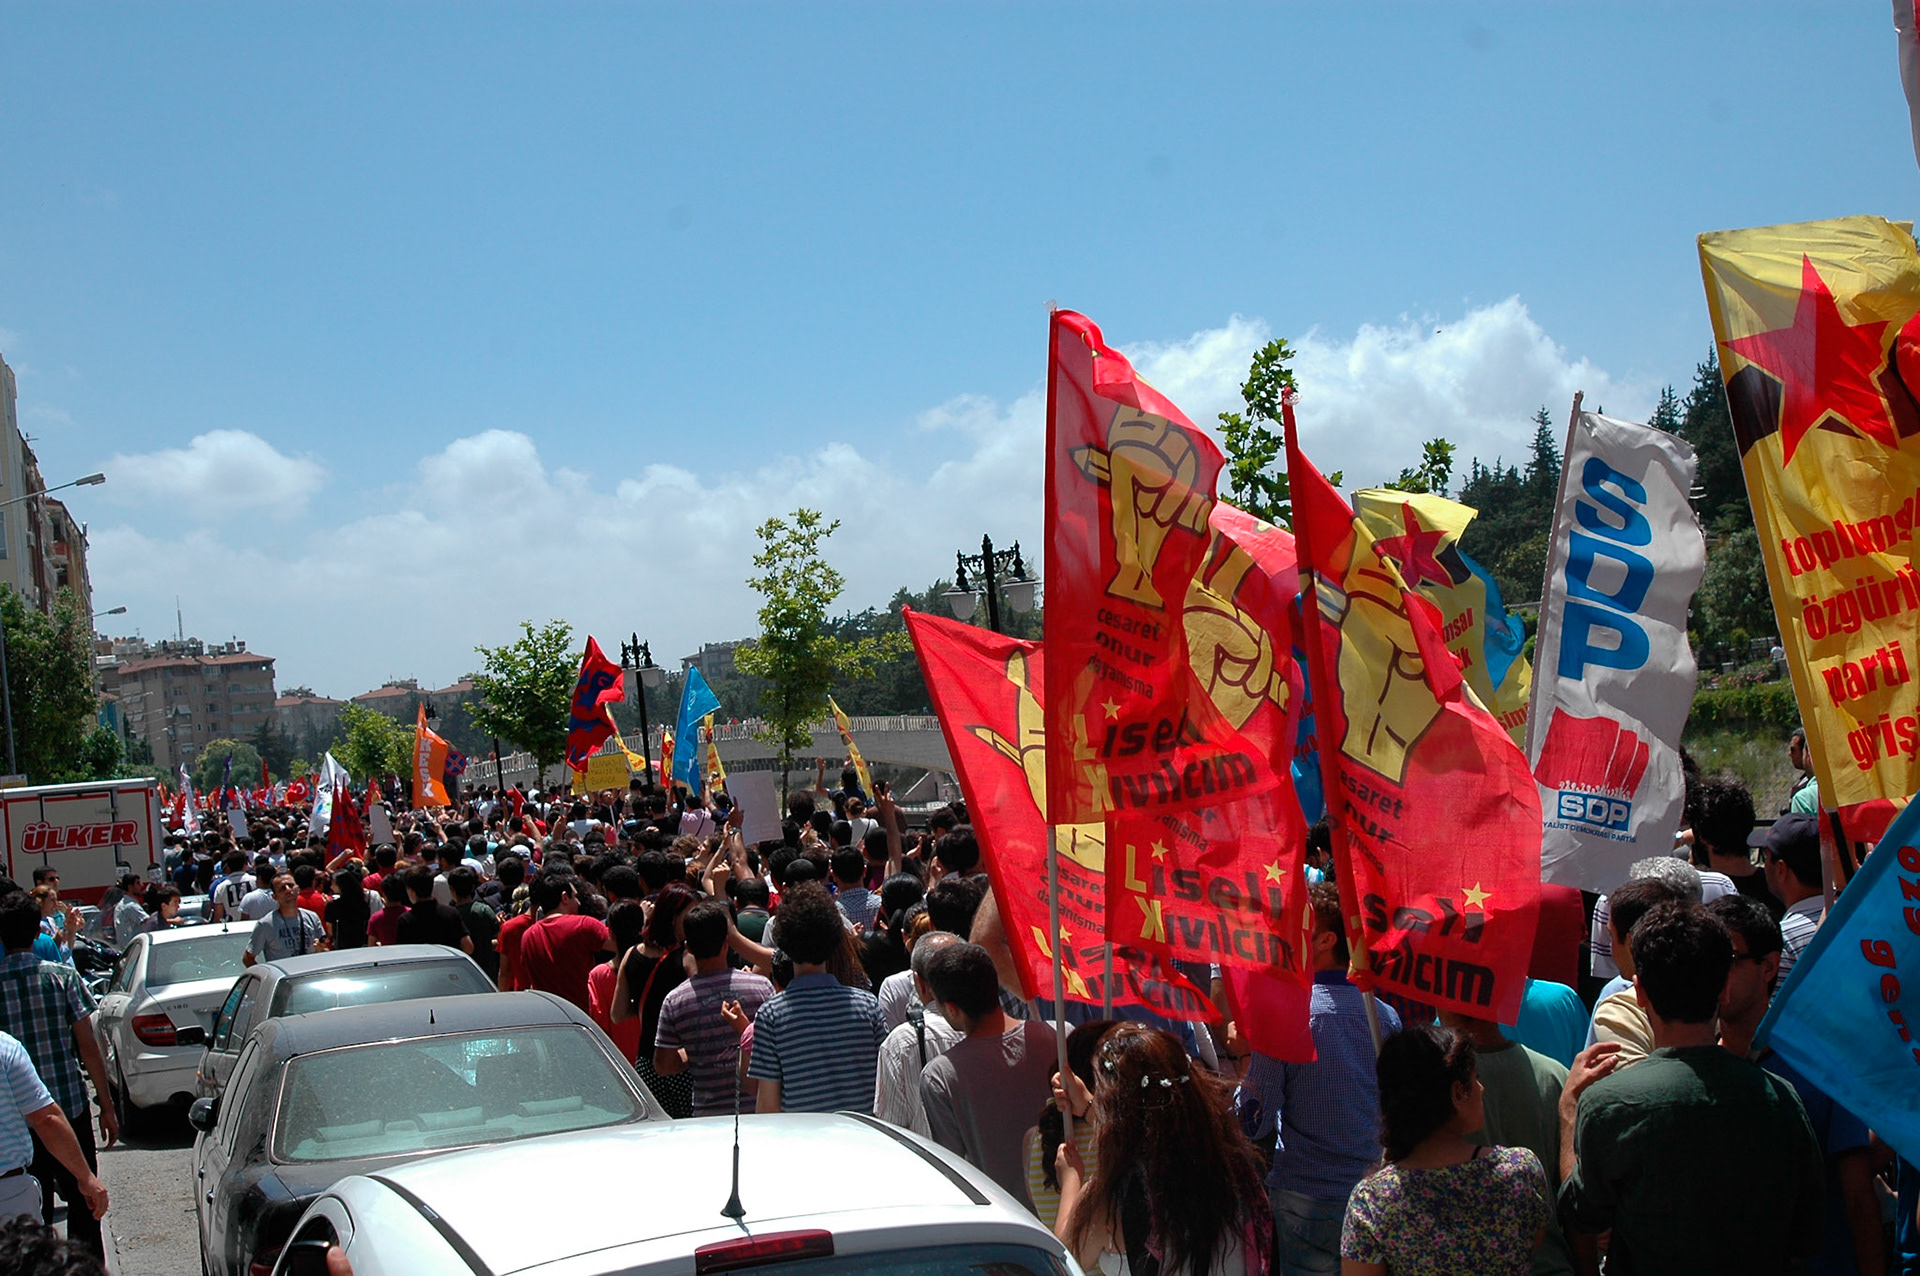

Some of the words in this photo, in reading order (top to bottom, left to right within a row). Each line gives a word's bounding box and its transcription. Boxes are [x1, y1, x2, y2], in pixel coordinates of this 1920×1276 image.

[1558, 457, 1654, 682] SDP
[1096, 631, 1156, 668] onur
[1098, 608, 1161, 642] cesaret
[1821, 640, 1911, 709] parti
[1847, 705, 1920, 771] giriş
[418, 737, 435, 798] KESK
[1341, 769, 1404, 820] esaret
[21, 820, 138, 855] ÜLKER
[1560, 794, 1629, 825] SDP
[1125, 843, 1283, 920] Liseli
